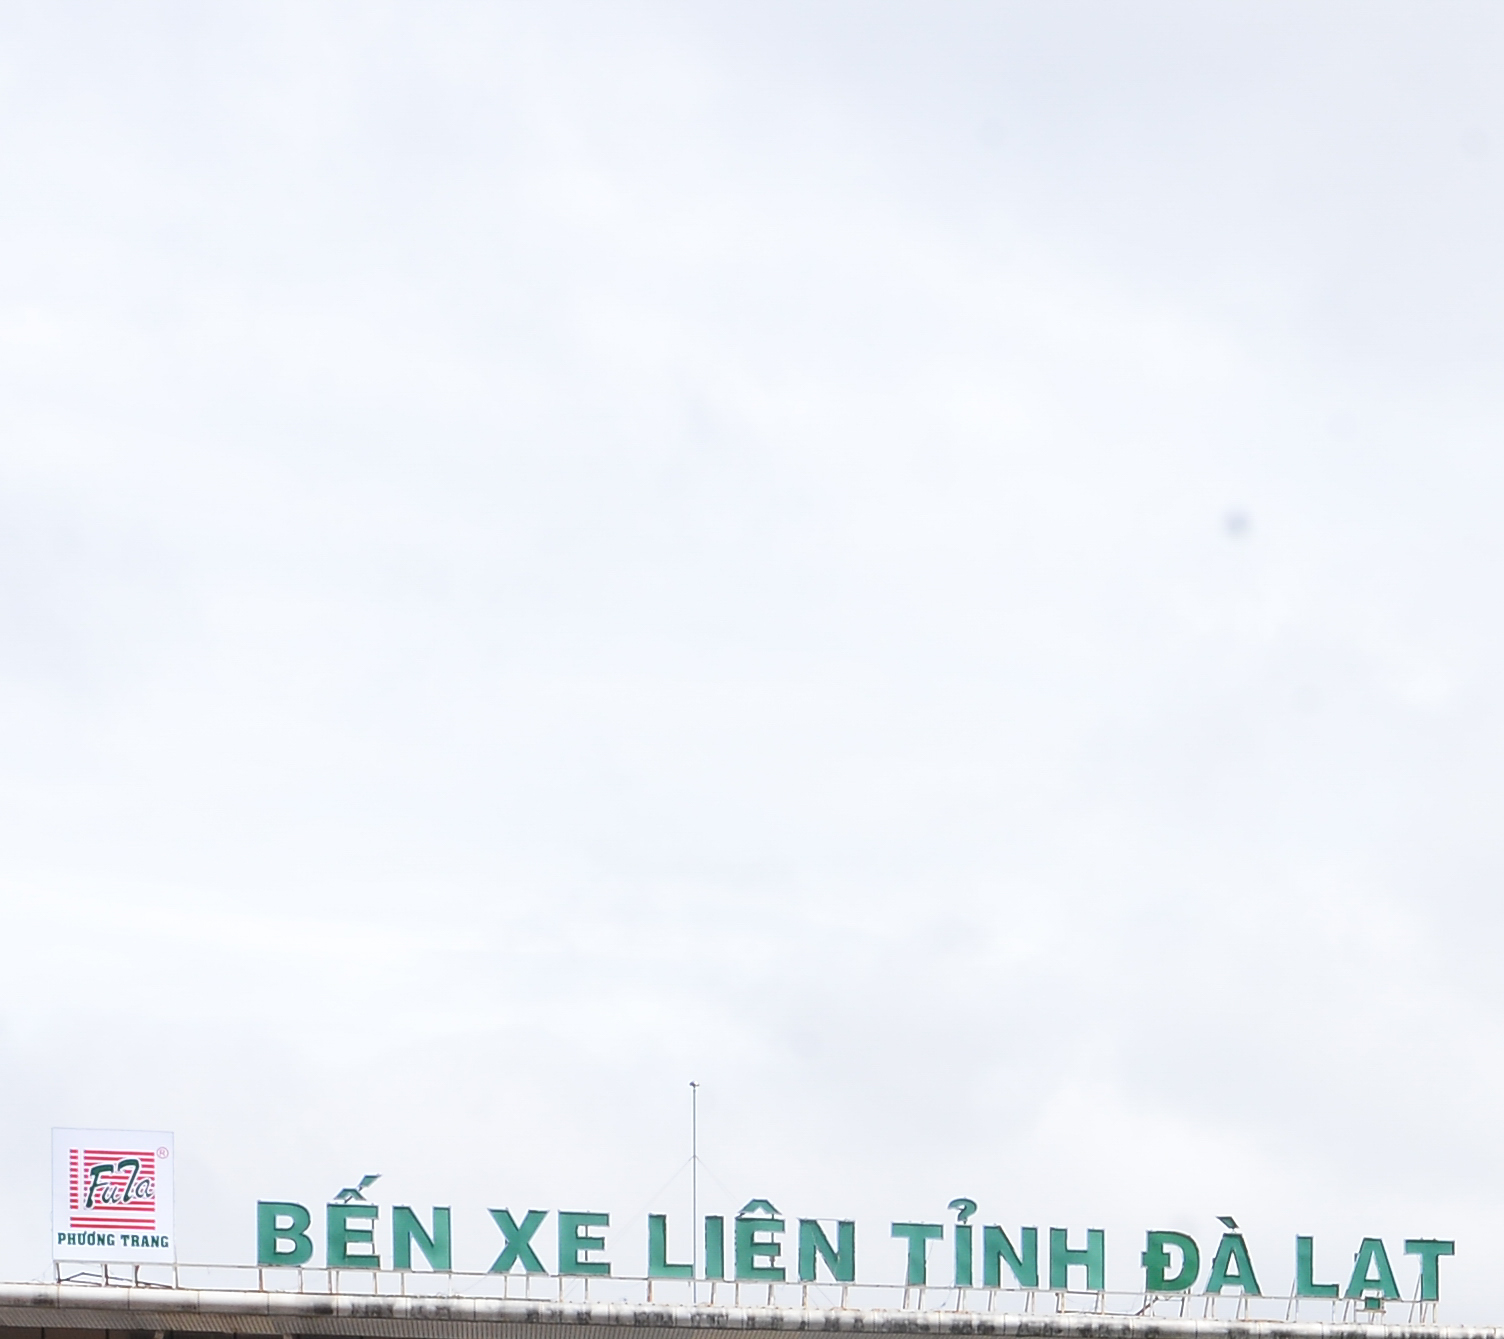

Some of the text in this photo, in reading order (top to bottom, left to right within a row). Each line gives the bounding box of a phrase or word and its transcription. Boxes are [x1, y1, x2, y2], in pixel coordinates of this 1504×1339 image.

[58, 1231, 169, 1248] PHƯƠNG TRANG
[257, 1174, 1455, 1309] BẾN XE LIÊN TỈNH ĐÀ LẠT
